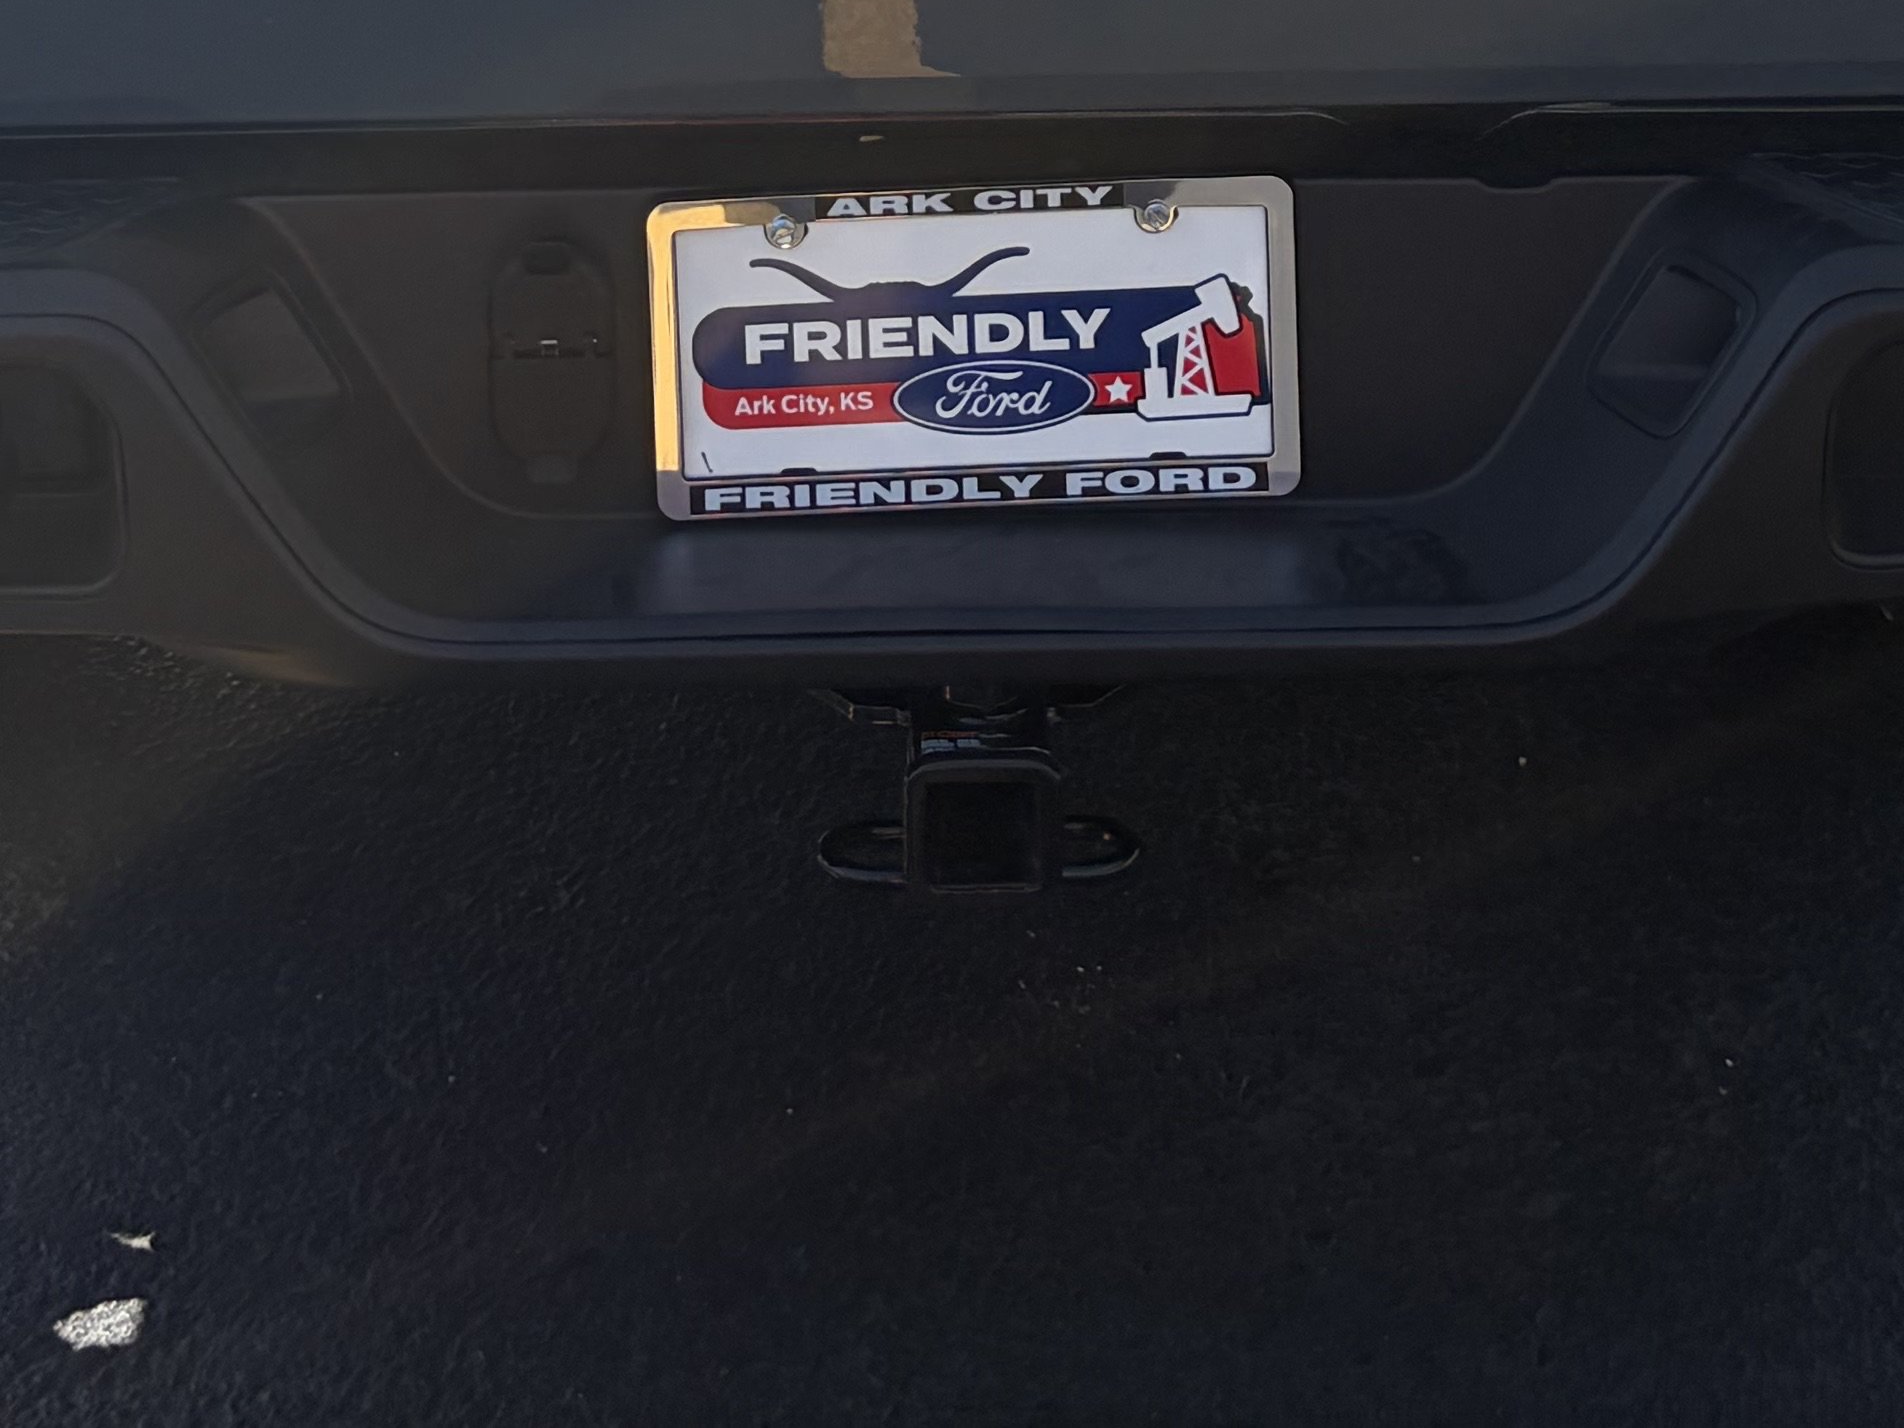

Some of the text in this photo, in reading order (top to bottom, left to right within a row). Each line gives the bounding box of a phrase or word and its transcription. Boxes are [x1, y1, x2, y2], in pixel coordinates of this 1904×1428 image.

[826, 185, 1114, 219] ARK CITY
[743, 307, 1112, 366] FRIENDLY
[733, 391, 874, 418] Ark City, KS
[936, 370, 1053, 419] Ford
[704, 465, 1258, 512] FRIENDLY FORD
